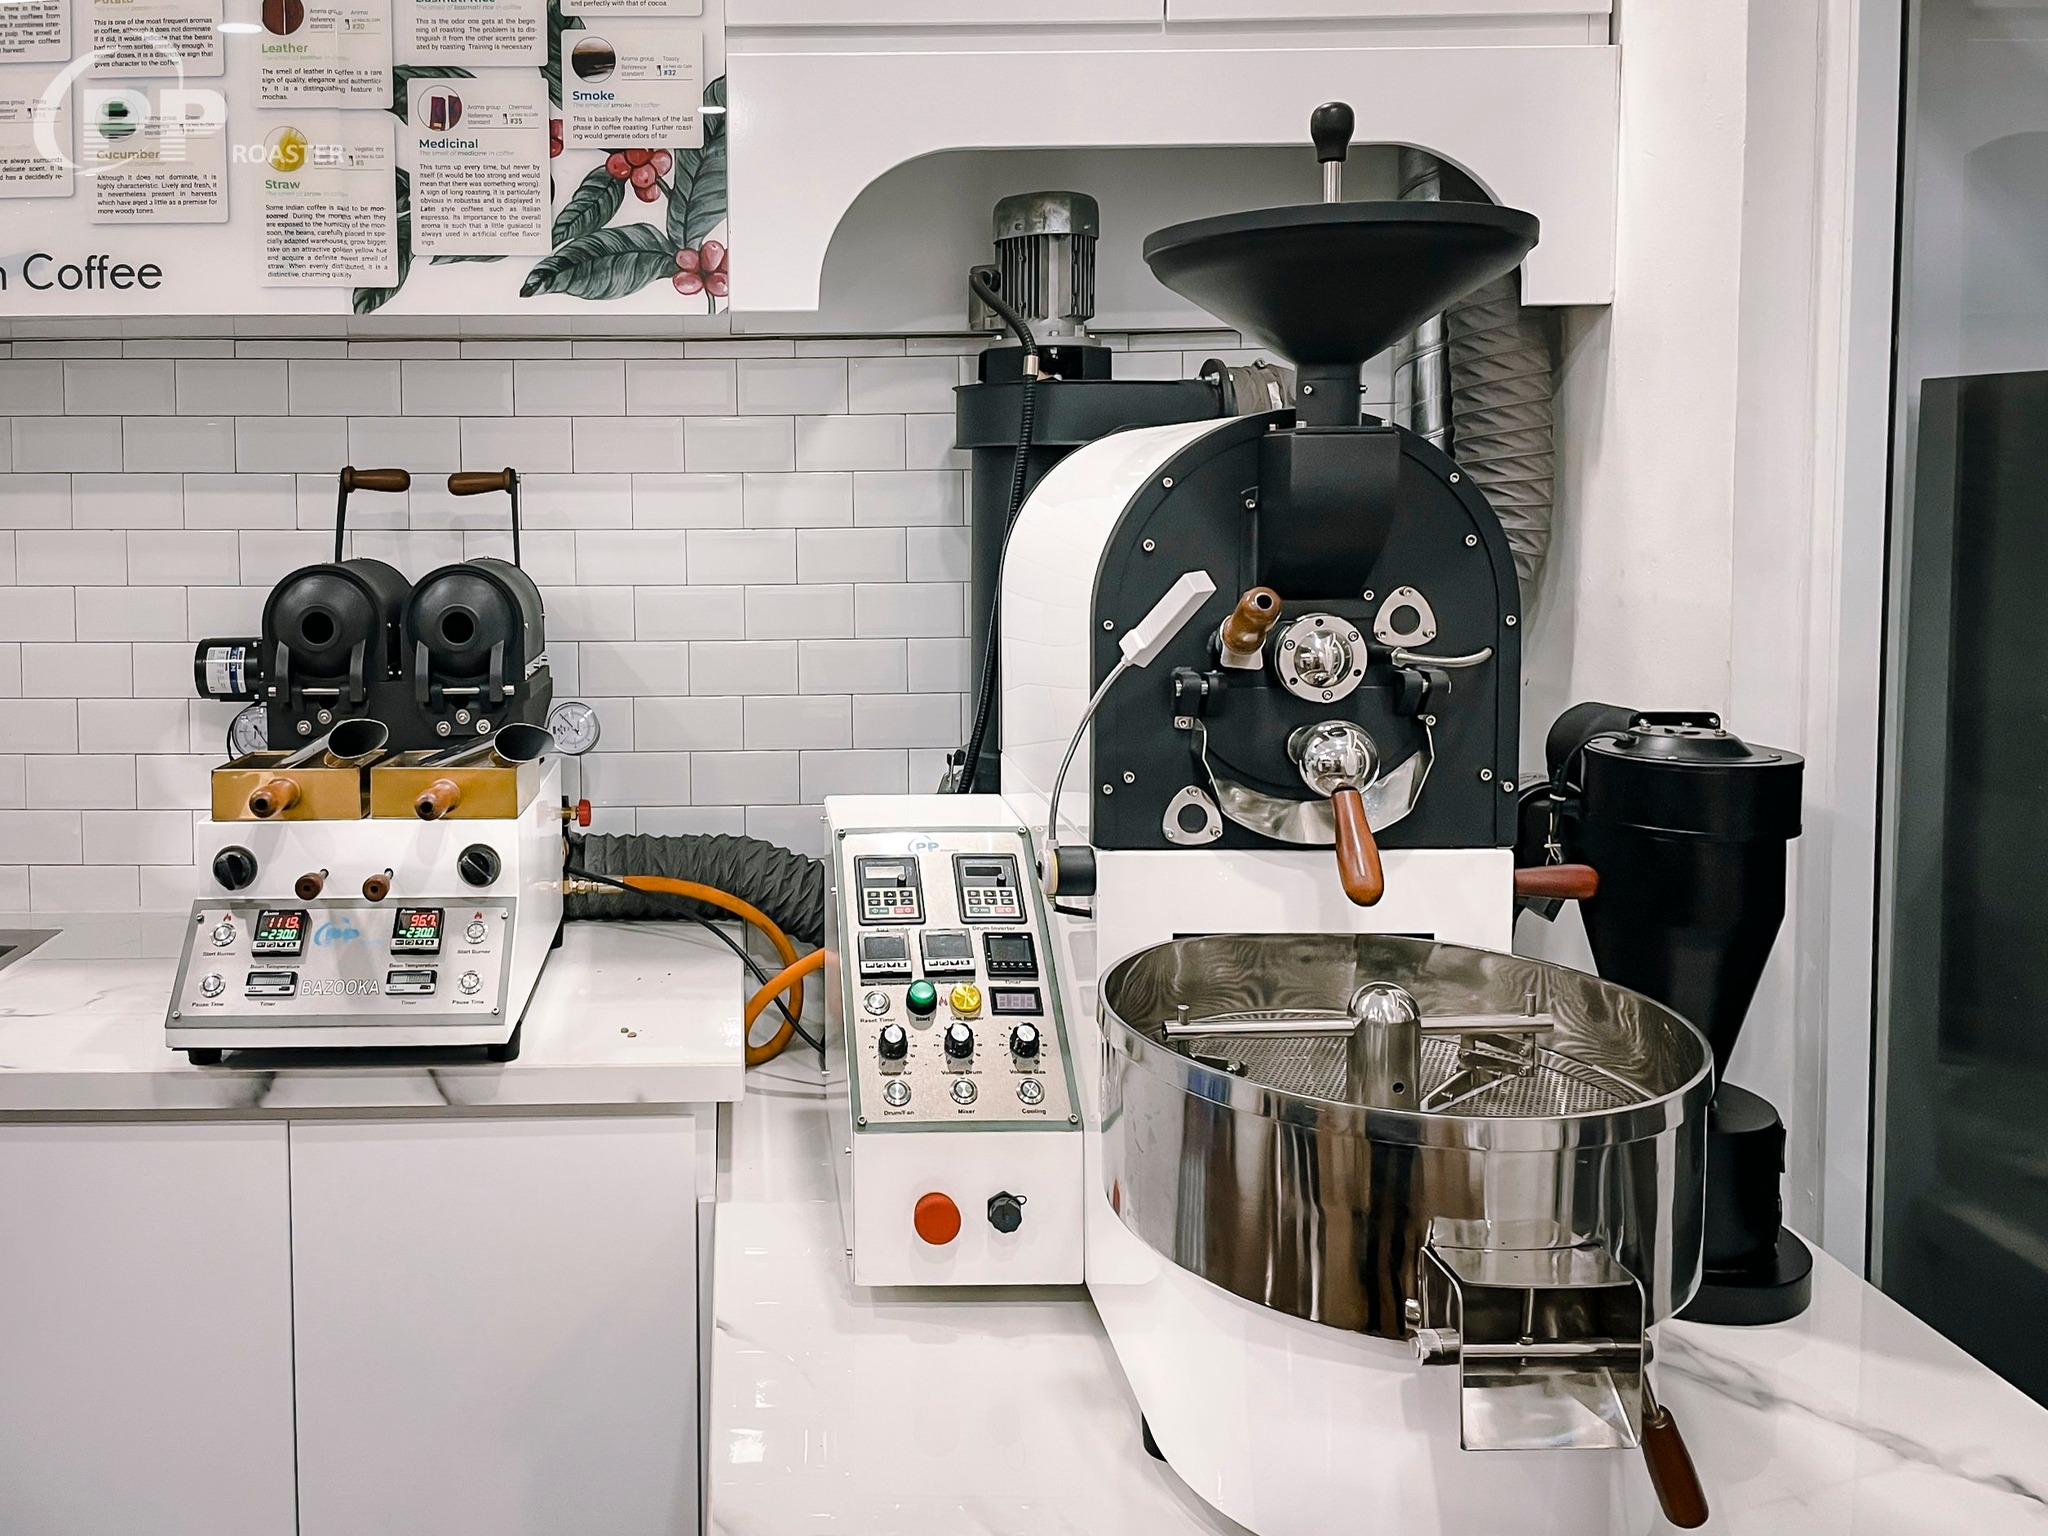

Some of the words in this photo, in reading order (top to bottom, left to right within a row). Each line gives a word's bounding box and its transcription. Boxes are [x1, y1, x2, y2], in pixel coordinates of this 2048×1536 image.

[162, 18, 189, 26] frequent
[262, 43, 309, 53] Leather
[572, 90, 615, 100] Smoke
[573, 124, 591, 132] phase
[420, 138, 478, 148] Medicinal
[96, 150, 160, 160] Cucumber
[487, 172, 507, 180] strong
[97, 183, 115, 191] highly
[265, 180, 301, 189] Straw
[22, 252, 163, 290] Coffee
[915, 842, 939, 853] PP
[301, 979, 380, 996] BAZOOKA
